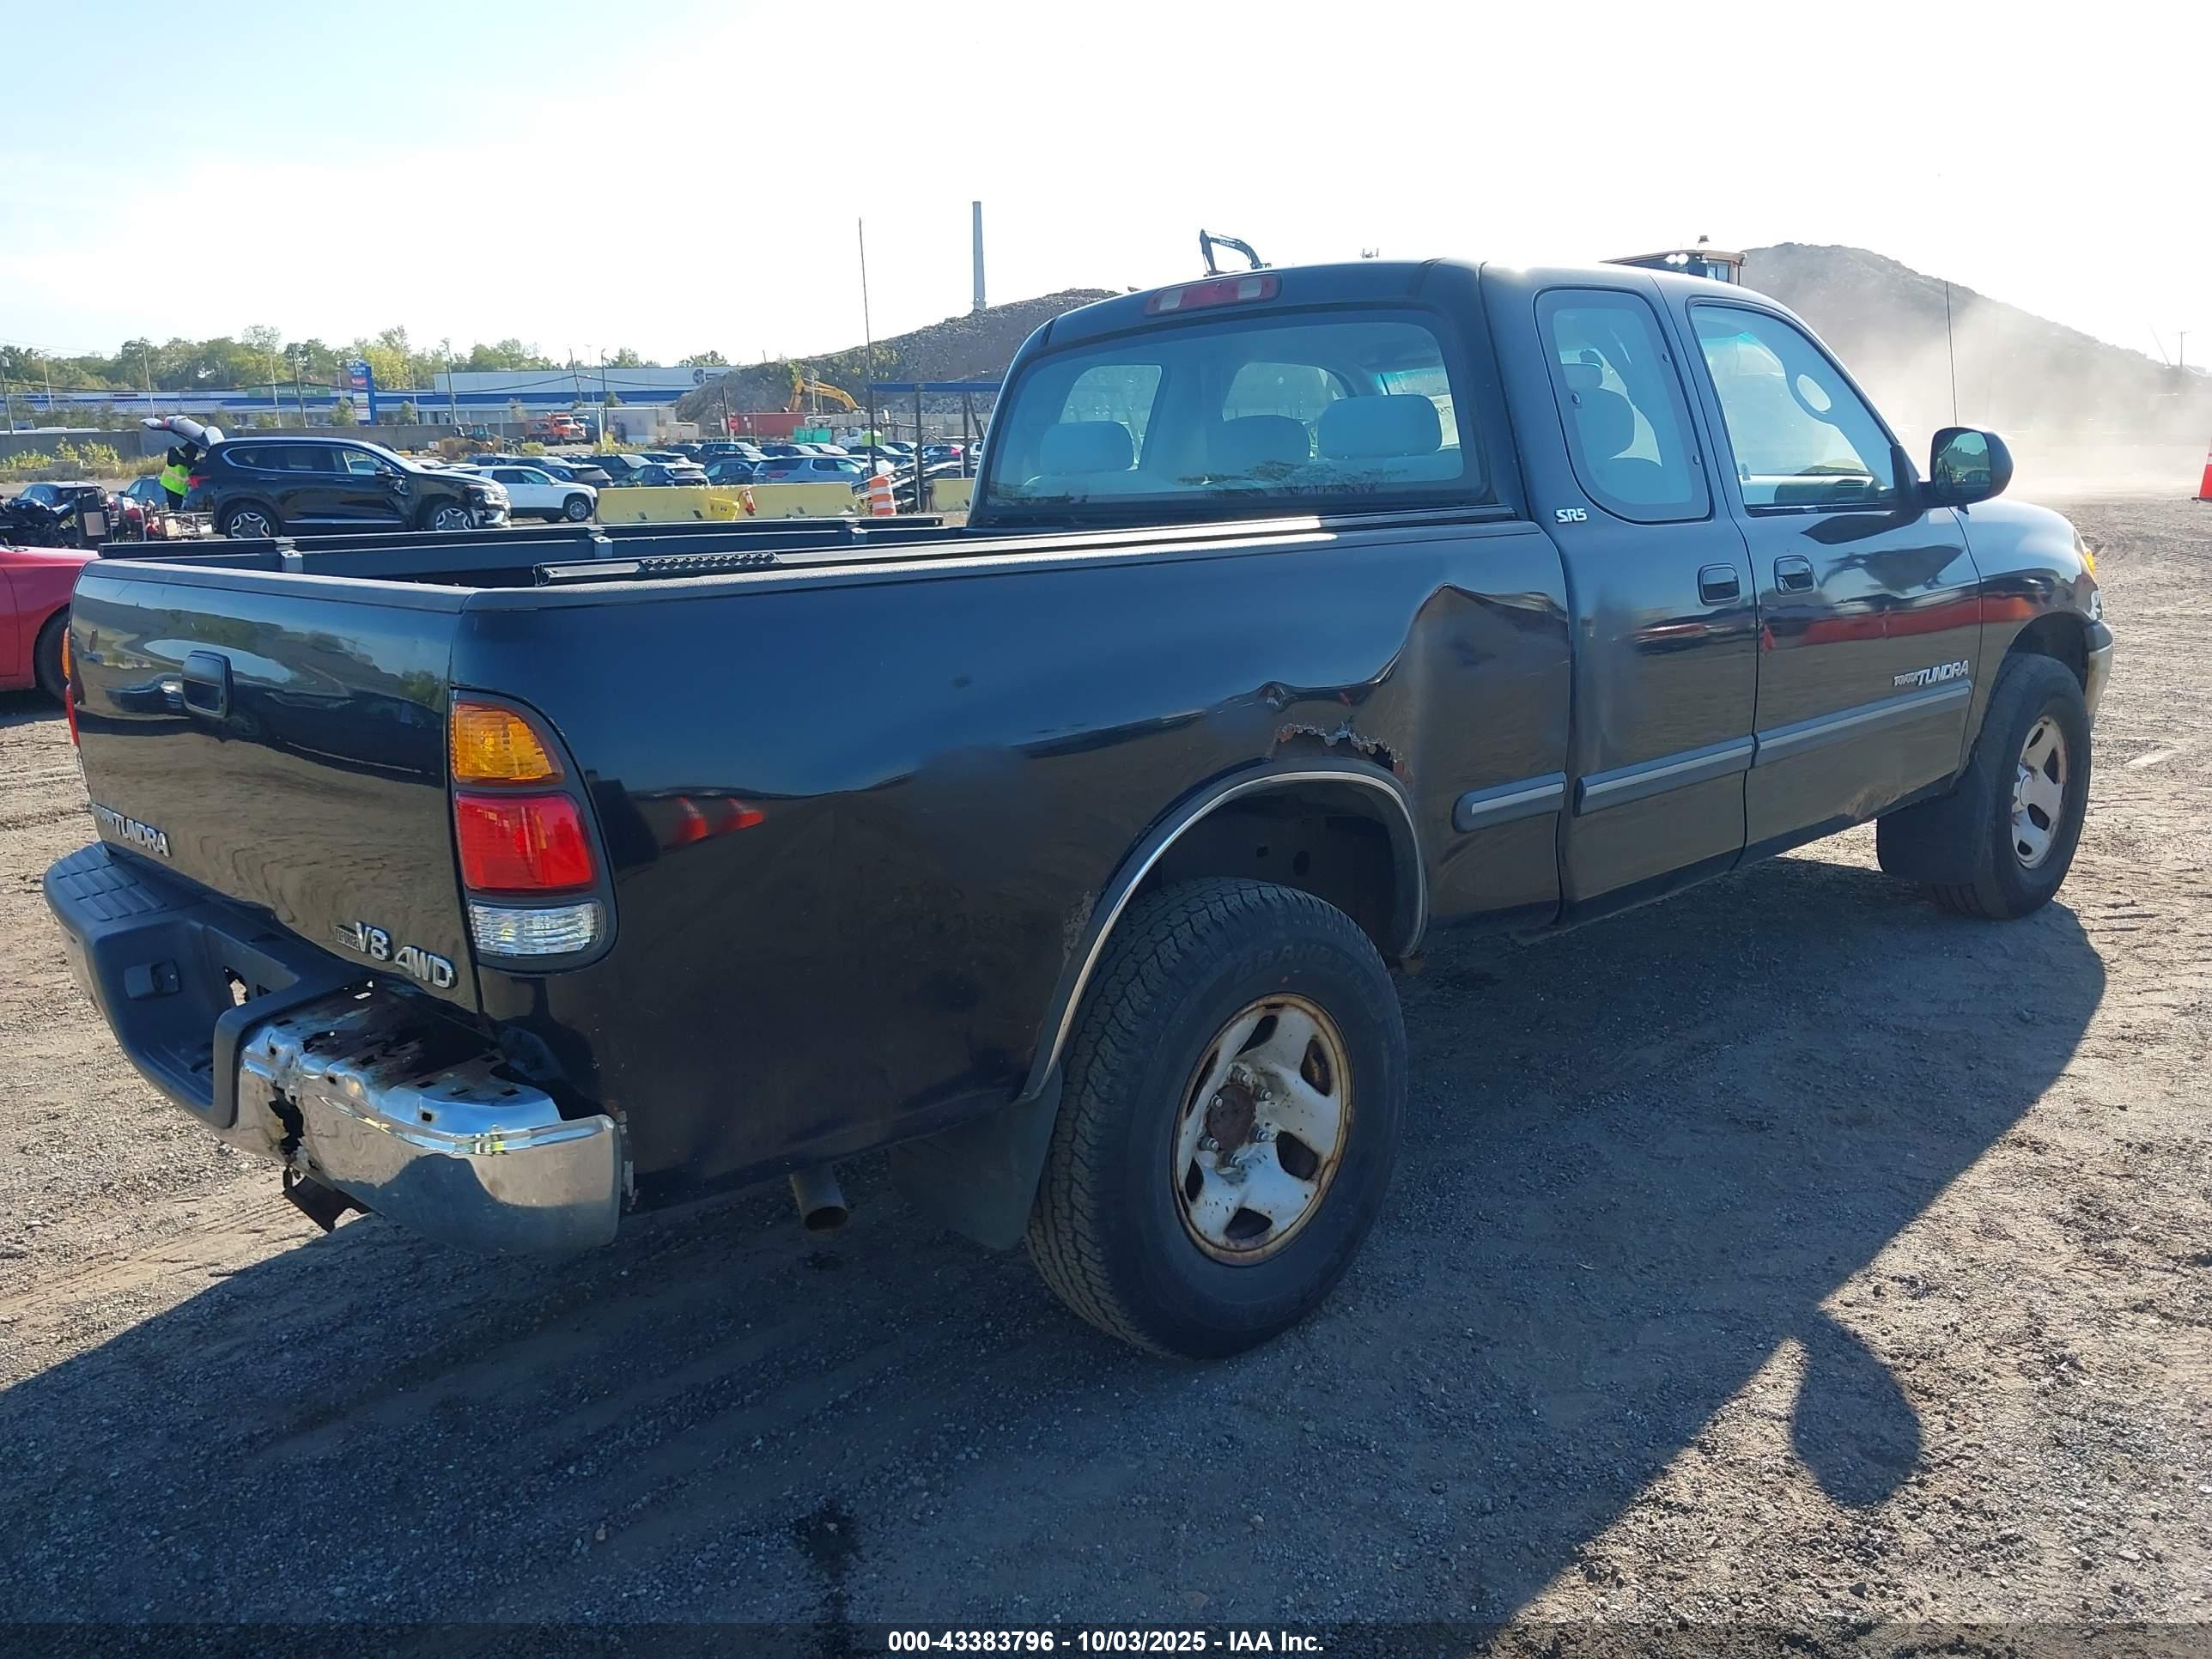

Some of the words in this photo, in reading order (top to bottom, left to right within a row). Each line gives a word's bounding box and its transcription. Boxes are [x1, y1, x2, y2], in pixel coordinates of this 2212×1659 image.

[1555, 507, 1588, 523] SR5
[1917, 659, 1969, 686] TUNDRA
[112, 812, 171, 857] TUNDRA
[395, 945, 455, 988] 4WD
